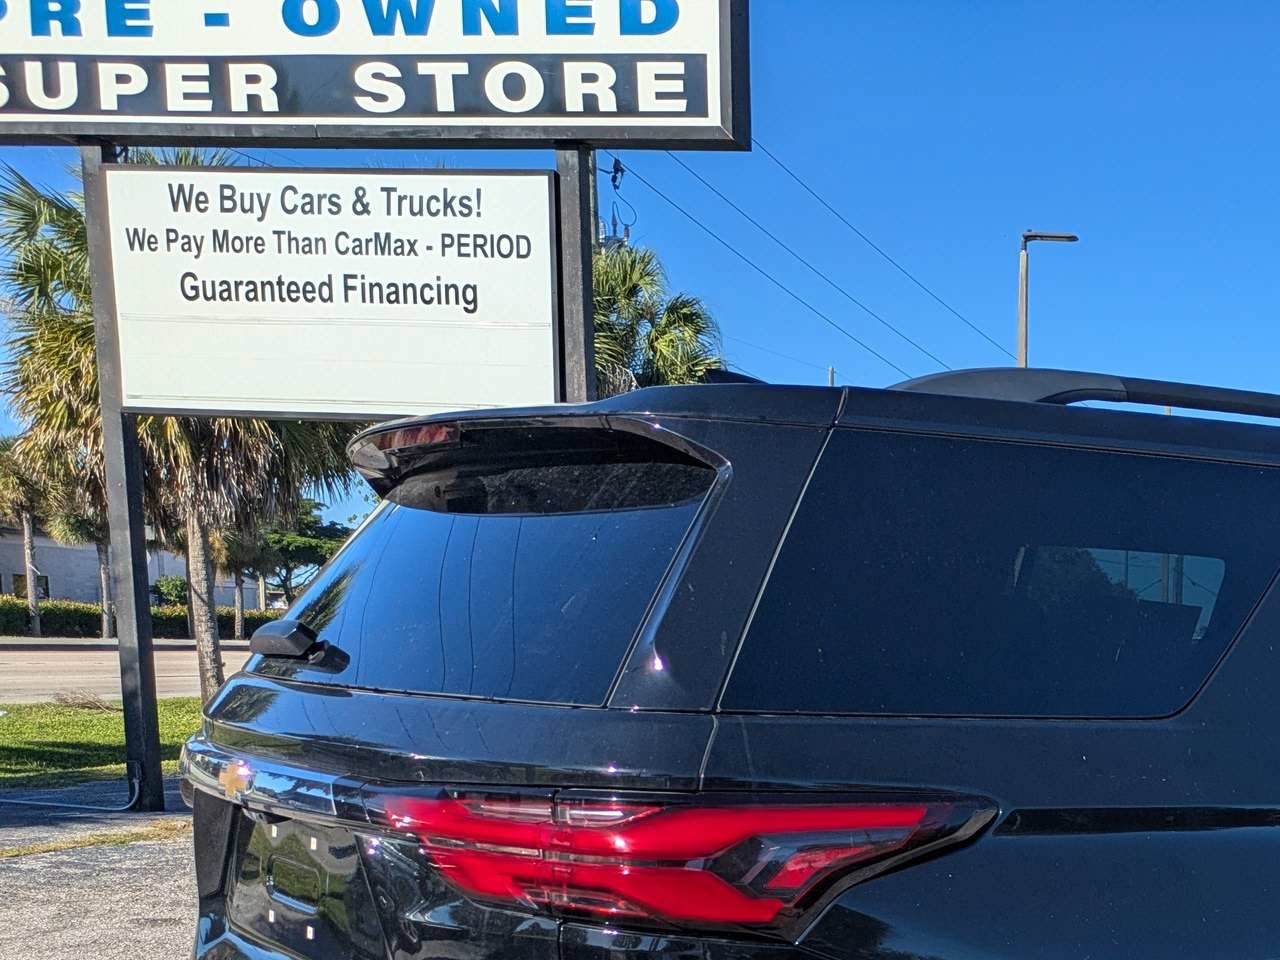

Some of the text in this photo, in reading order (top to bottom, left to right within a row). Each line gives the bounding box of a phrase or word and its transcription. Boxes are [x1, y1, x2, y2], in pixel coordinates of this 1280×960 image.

[0, 0, 154, 37] RE
[282, 0, 680, 37] OWNED
[0, 60, 688, 113] UPER STORE
[168, 183, 482, 222] We Buy Cars & Trucks!
[125, 227, 159, 252] We
[166, 228, 204, 259] Pay
[212, 229, 266, 254] More
[272, 230, 327, 255] Than
[335, 231, 419, 257] CarMax
[441, 233, 532, 259] PERIOD
[180, 271, 478, 314] Guaranteed Financing
